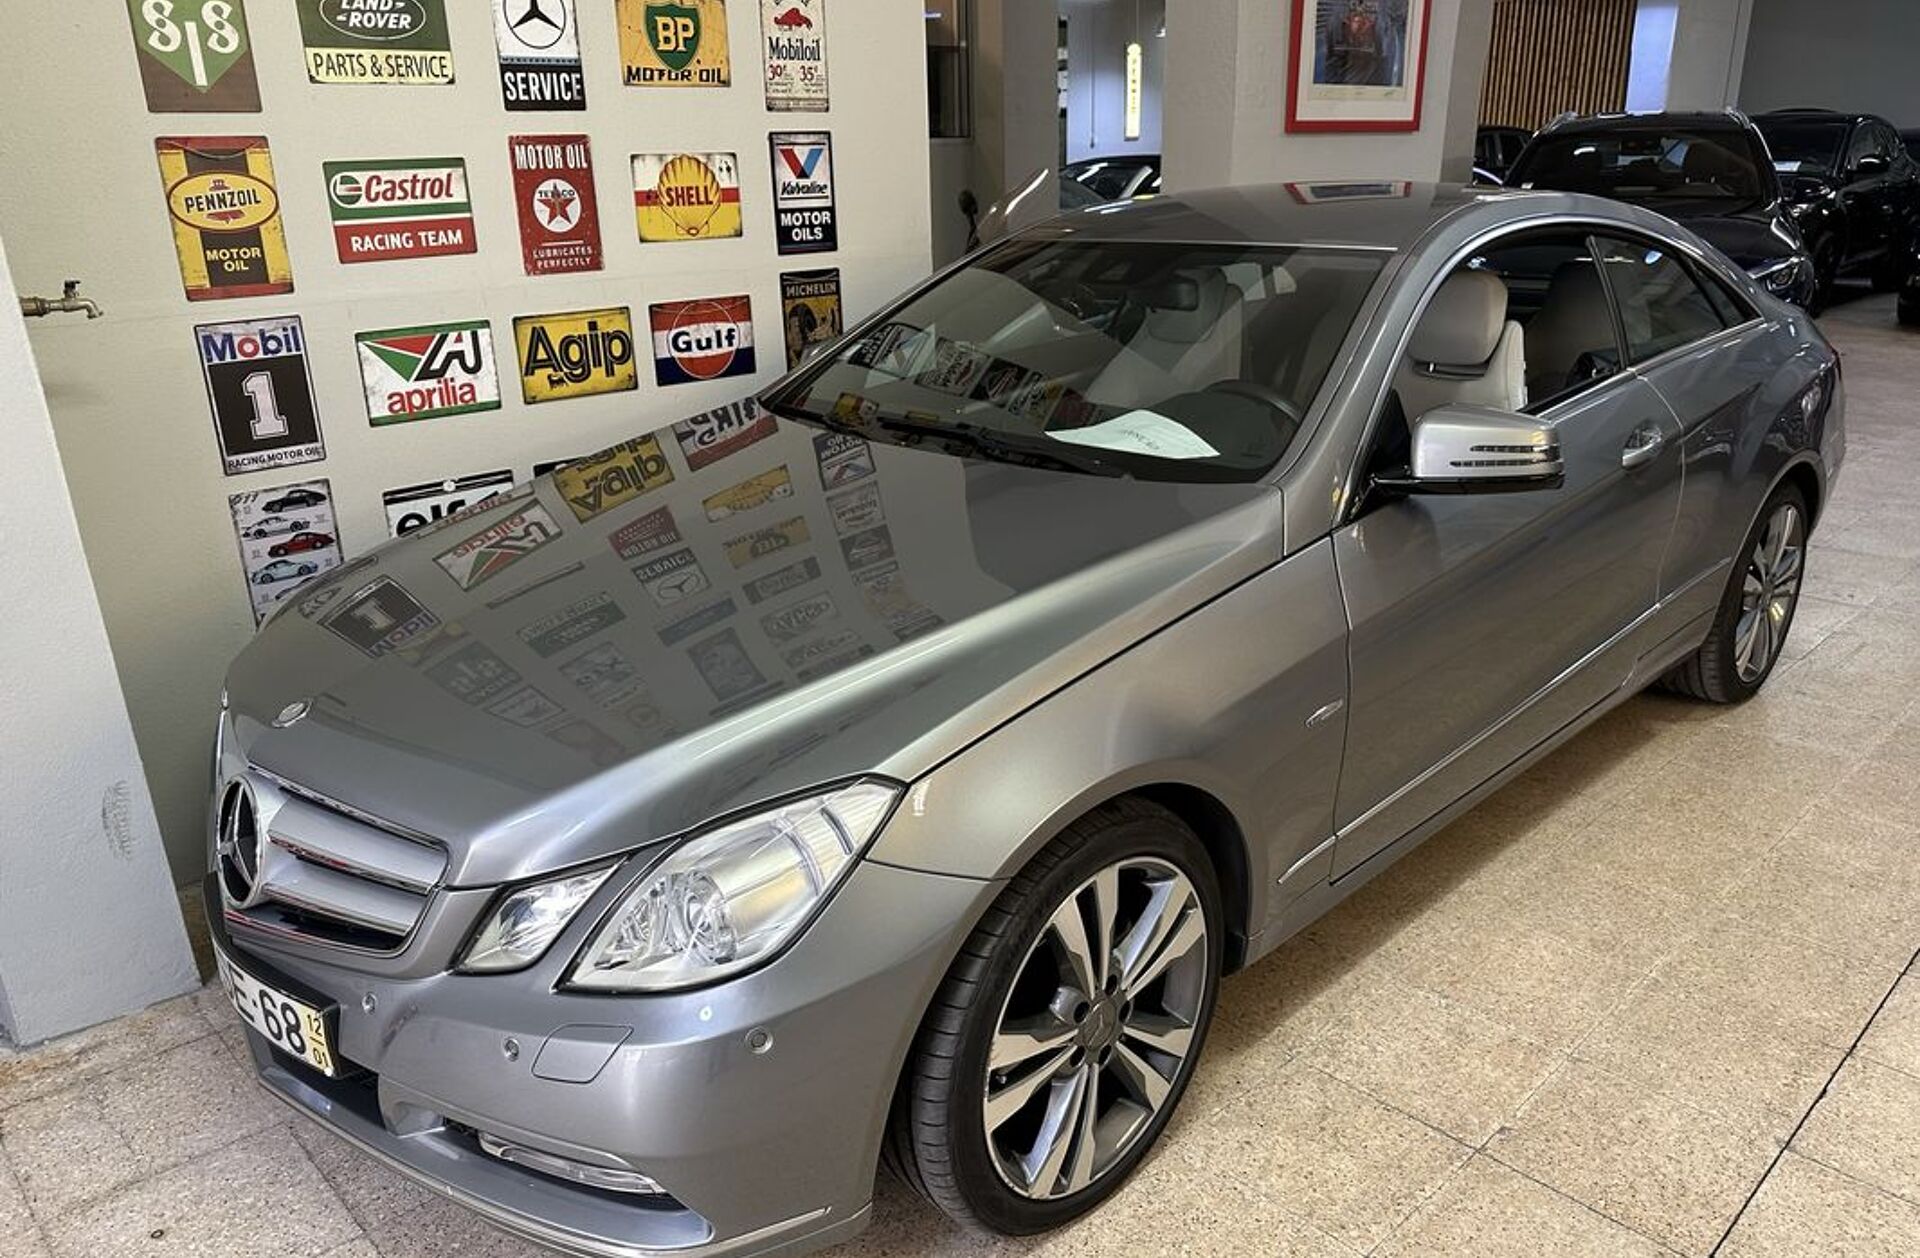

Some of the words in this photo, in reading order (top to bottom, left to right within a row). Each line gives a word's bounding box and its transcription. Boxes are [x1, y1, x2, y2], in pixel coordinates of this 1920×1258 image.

[654, 16, 696, 51] BP
[768, 36, 822, 61] Mobiloil
[313, 52, 367, 77] PARTS
[370, 54, 383, 78] &
[385, 54, 449, 78] SERVICE
[626, 65, 692, 83] MOTOR
[698, 68, 727, 84] OIL
[504, 71, 583, 101] SERVICE
[515, 144, 563, 170] MOTOR
[566, 144, 588, 169] OIL
[365, 173, 454, 202] Castrol
[665, 185, 714, 208] SHELL
[184, 188, 262, 214] PENNZOIL
[781, 211, 832, 227] MOTOR
[351, 233, 413, 253] RACING
[418, 230, 463, 247] TEAM
[791, 227, 823, 242] OILS
[206, 247, 262, 263] MOTOR
[532, 246, 593, 259] LUBRICATES
[537, 257, 591, 270] PERFECTLY
[224, 260, 249, 272] OIL
[786, 282, 836, 297] MICHELIN
[201, 325, 303, 363] Mobil
[671, 327, 735, 351] Gulf
[524, 321, 633, 382] Agip
[241, 371, 289, 440] 1
[387, 379, 476, 414] aprilia
[228, 456, 267, 470] RACING
[267, 449, 305, 463] MOTOR
[307, 1014, 323, 1038] 12
